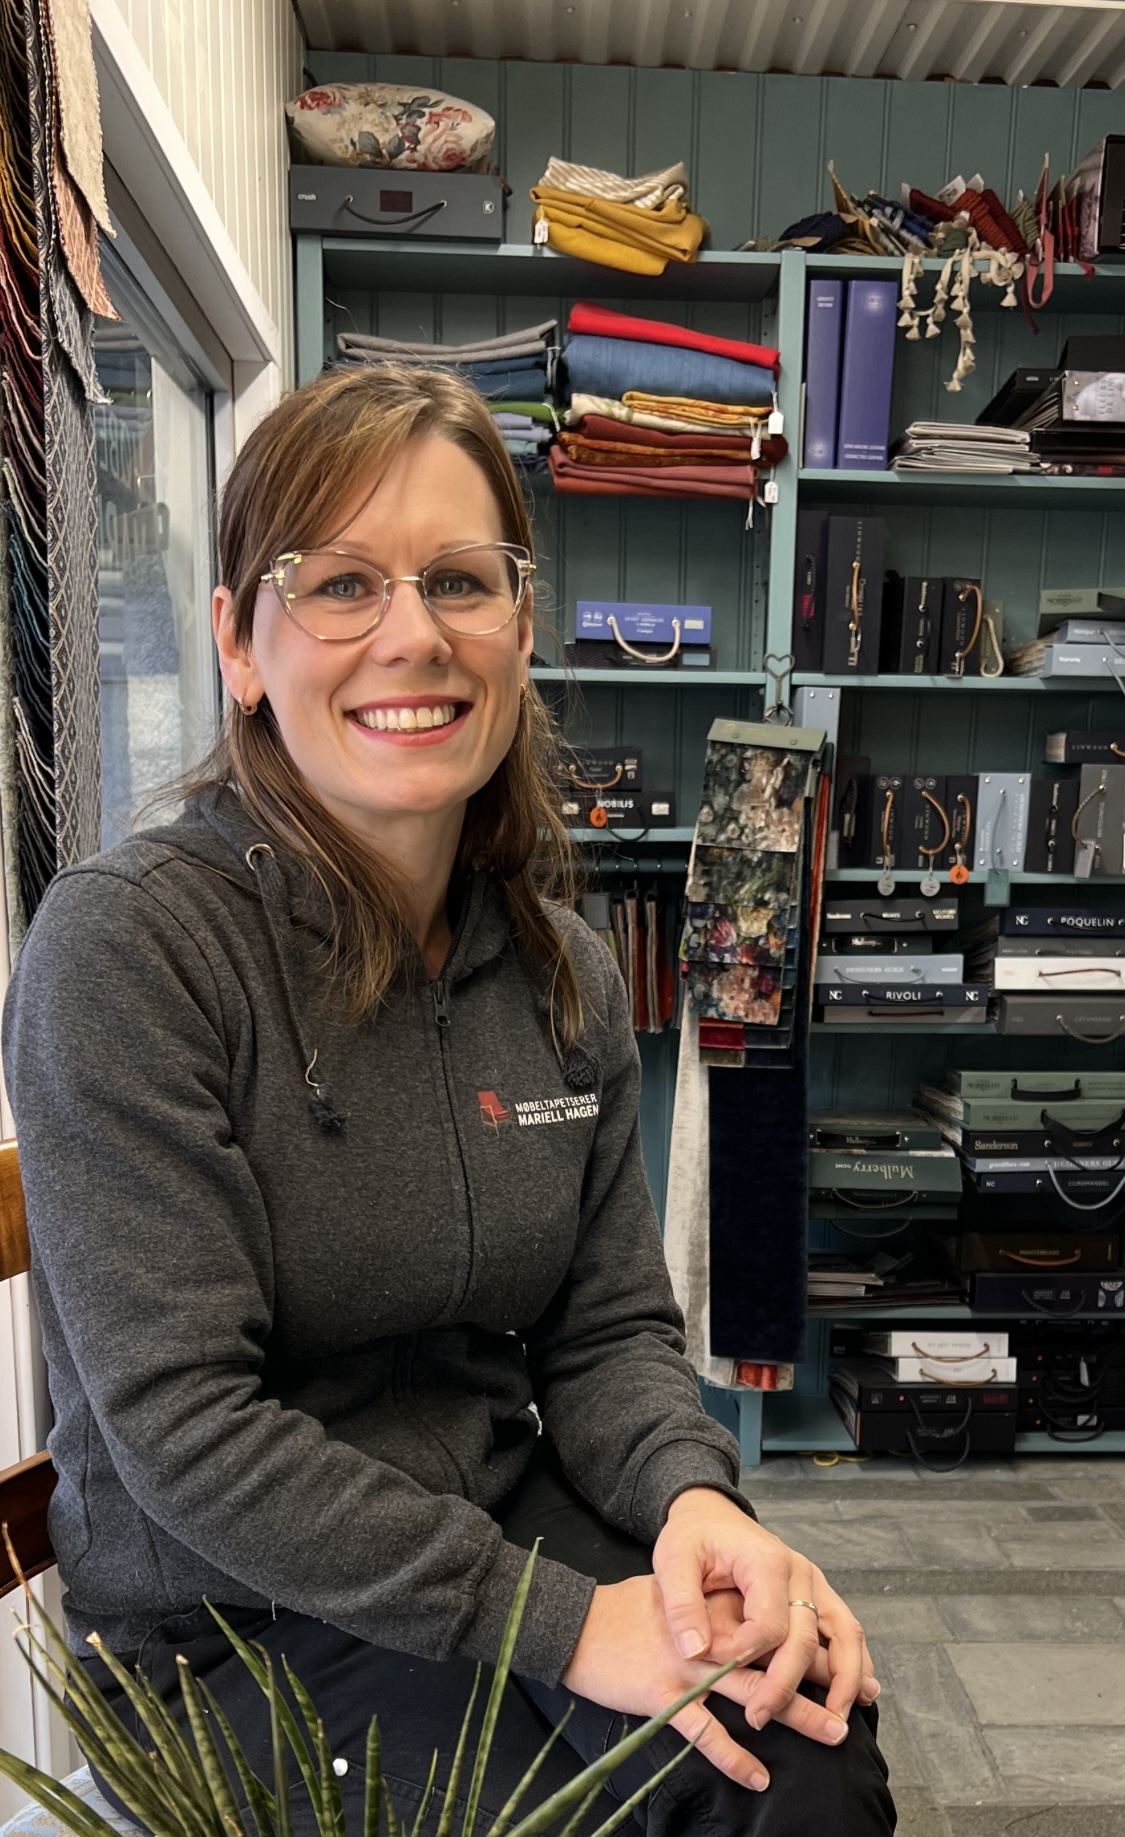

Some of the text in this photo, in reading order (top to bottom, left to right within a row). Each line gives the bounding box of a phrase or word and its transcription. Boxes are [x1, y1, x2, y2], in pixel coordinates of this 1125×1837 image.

[1060, 917, 1115, 928] POQUELIN
[886, 991, 921, 1001] RIVOLI
[515, 1094, 598, 1113] MØBELTAPETSERER
[518, 1104, 599, 1126] MARIELL HAGEN
[974, 1140, 1018, 1151] Sanderson
[853, 1161, 914, 1179] Mulberry
